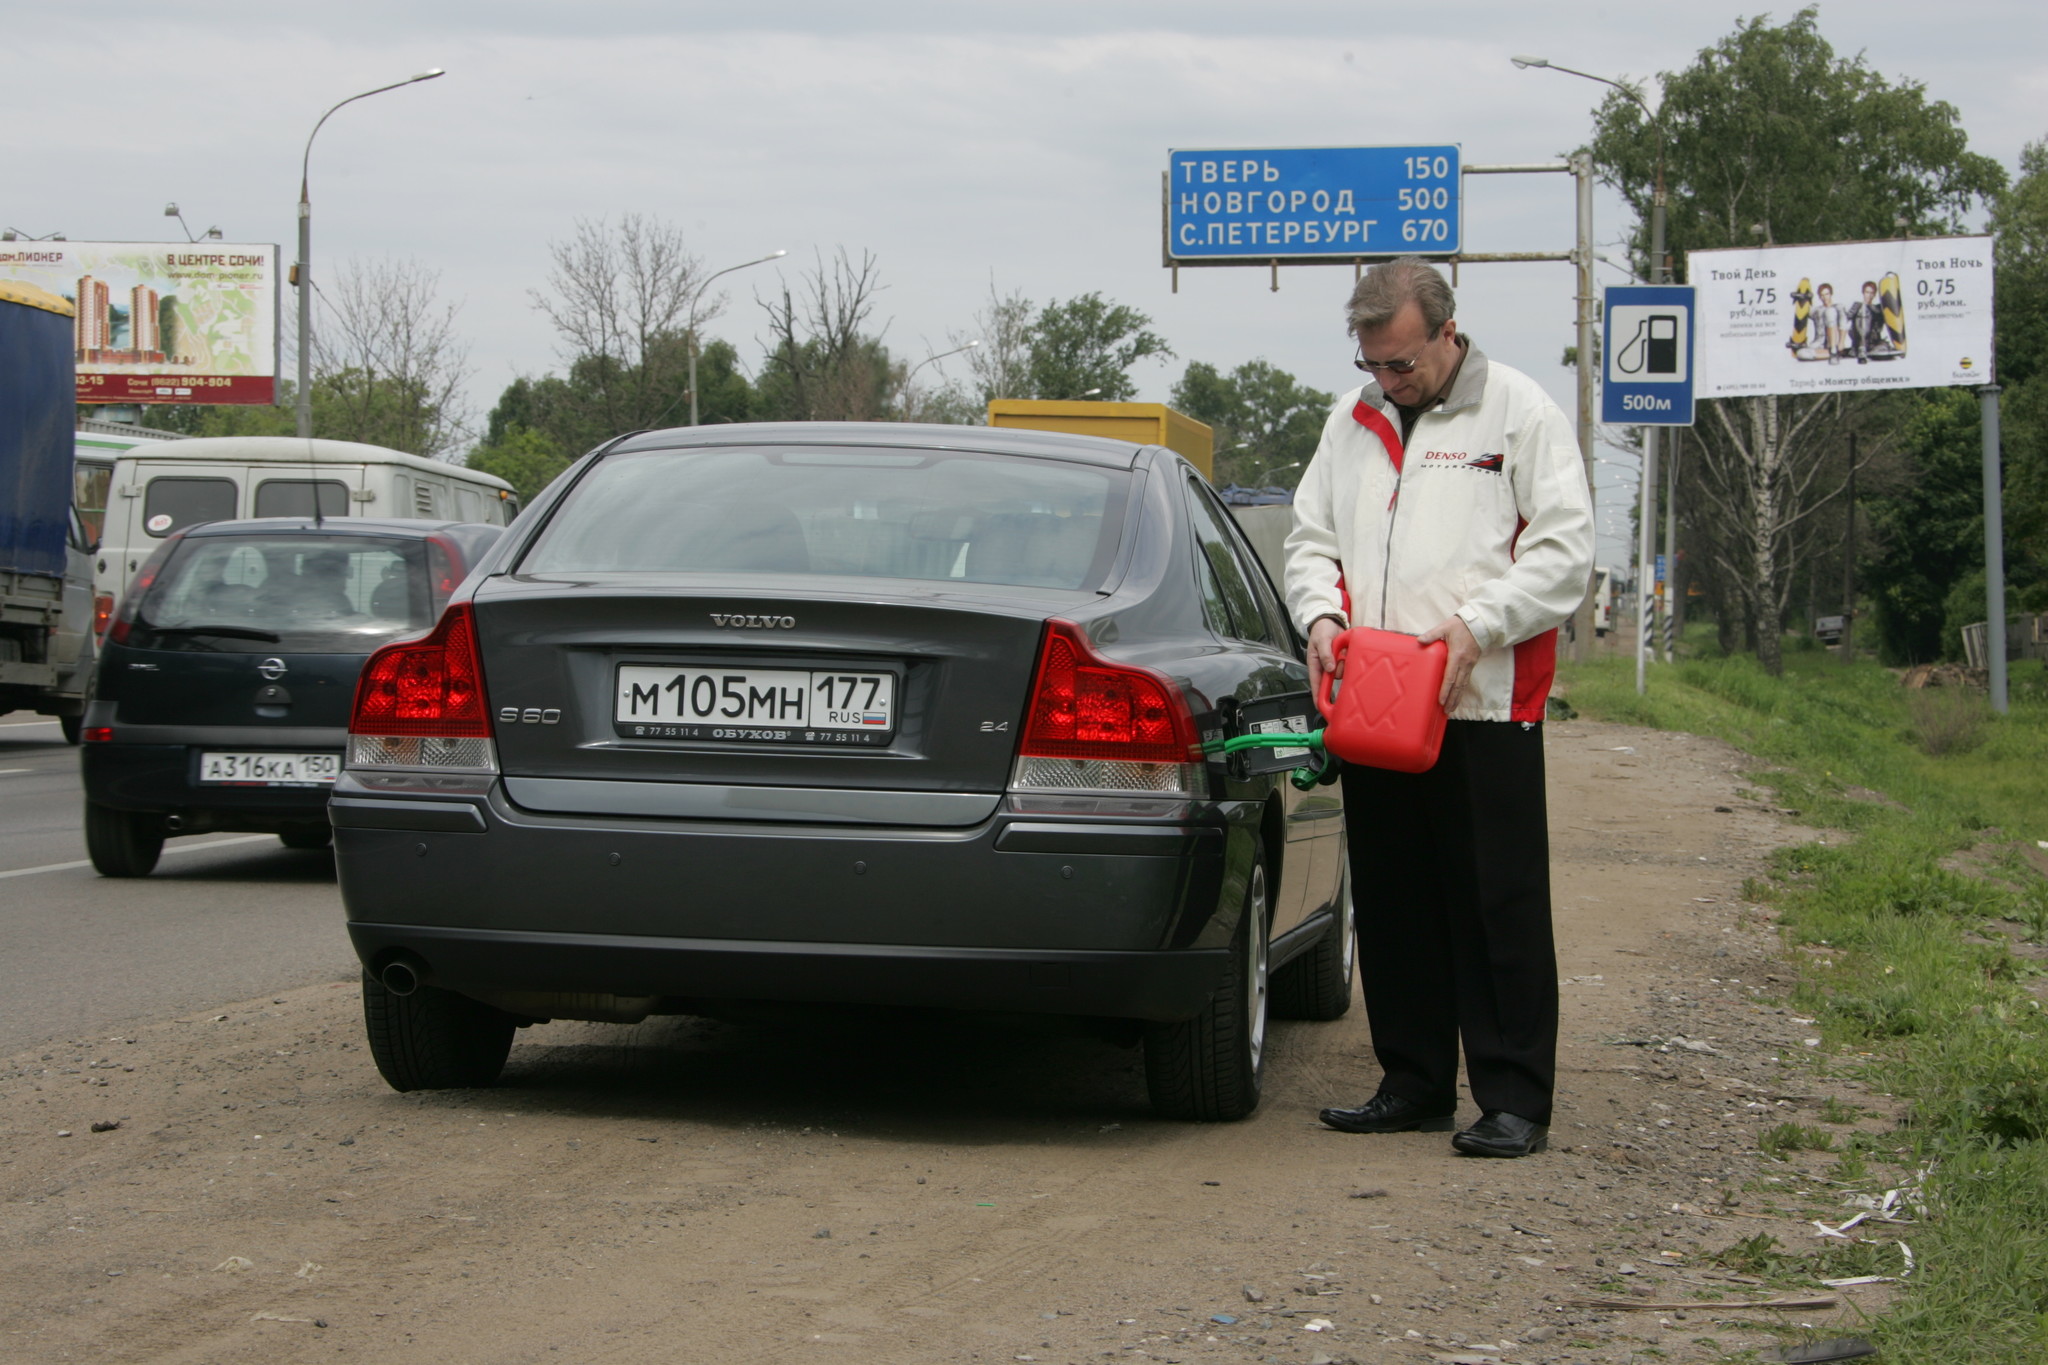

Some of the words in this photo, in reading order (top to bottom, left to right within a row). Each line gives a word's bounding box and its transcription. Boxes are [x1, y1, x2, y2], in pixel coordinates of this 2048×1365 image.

[1180, 160, 1280, 184] ТВЕРЬ
[1404, 156, 1449, 179] 150
[1181, 190, 1356, 215] НОВГОРОД
[1398, 187, 1449, 211] 500
[1180, 220, 1378, 245] С.ПЕТЕРБУРГ
[1402, 218, 1449, 242] 670
[167, 254, 175, 265] В
[178, 254, 225, 266] ЦЕНТРЕ
[229, 255, 264, 266] СОЧИ!
[1916, 259, 1946, 270] Твоя
[1950, 257, 1983, 269] Ночь
[1711, 268, 1741, 281] Твой
[1745, 268, 1777, 281] День
[1917, 278, 1955, 297] 0,75
[1738, 288, 1777, 306] 1,75
[1917, 298, 1967, 310] руб./мин.
[1729, 307, 1779, 319] руб./мин.
[181, 376, 232, 387] 904-904
[1623, 395, 1671, 410] 500м
[1424, 451, 1467, 460] DENSO
[710, 613, 796, 629] VOLVO
[817, 676, 881, 710] 177
[829, 711, 862, 724] RUS
[650, 727, 663, 736] 77
[665, 728, 677, 737] 55
[679, 728, 690, 737] 11
[692, 728, 699, 737] 4
[712, 728, 788, 741] ОБУХОВ
[820, 732, 832, 742] 77
[835, 733, 847, 742] 55
[851, 733, 861, 742] 11
[863, 733, 870, 742] 4
[300, 756, 334, 772] 150
